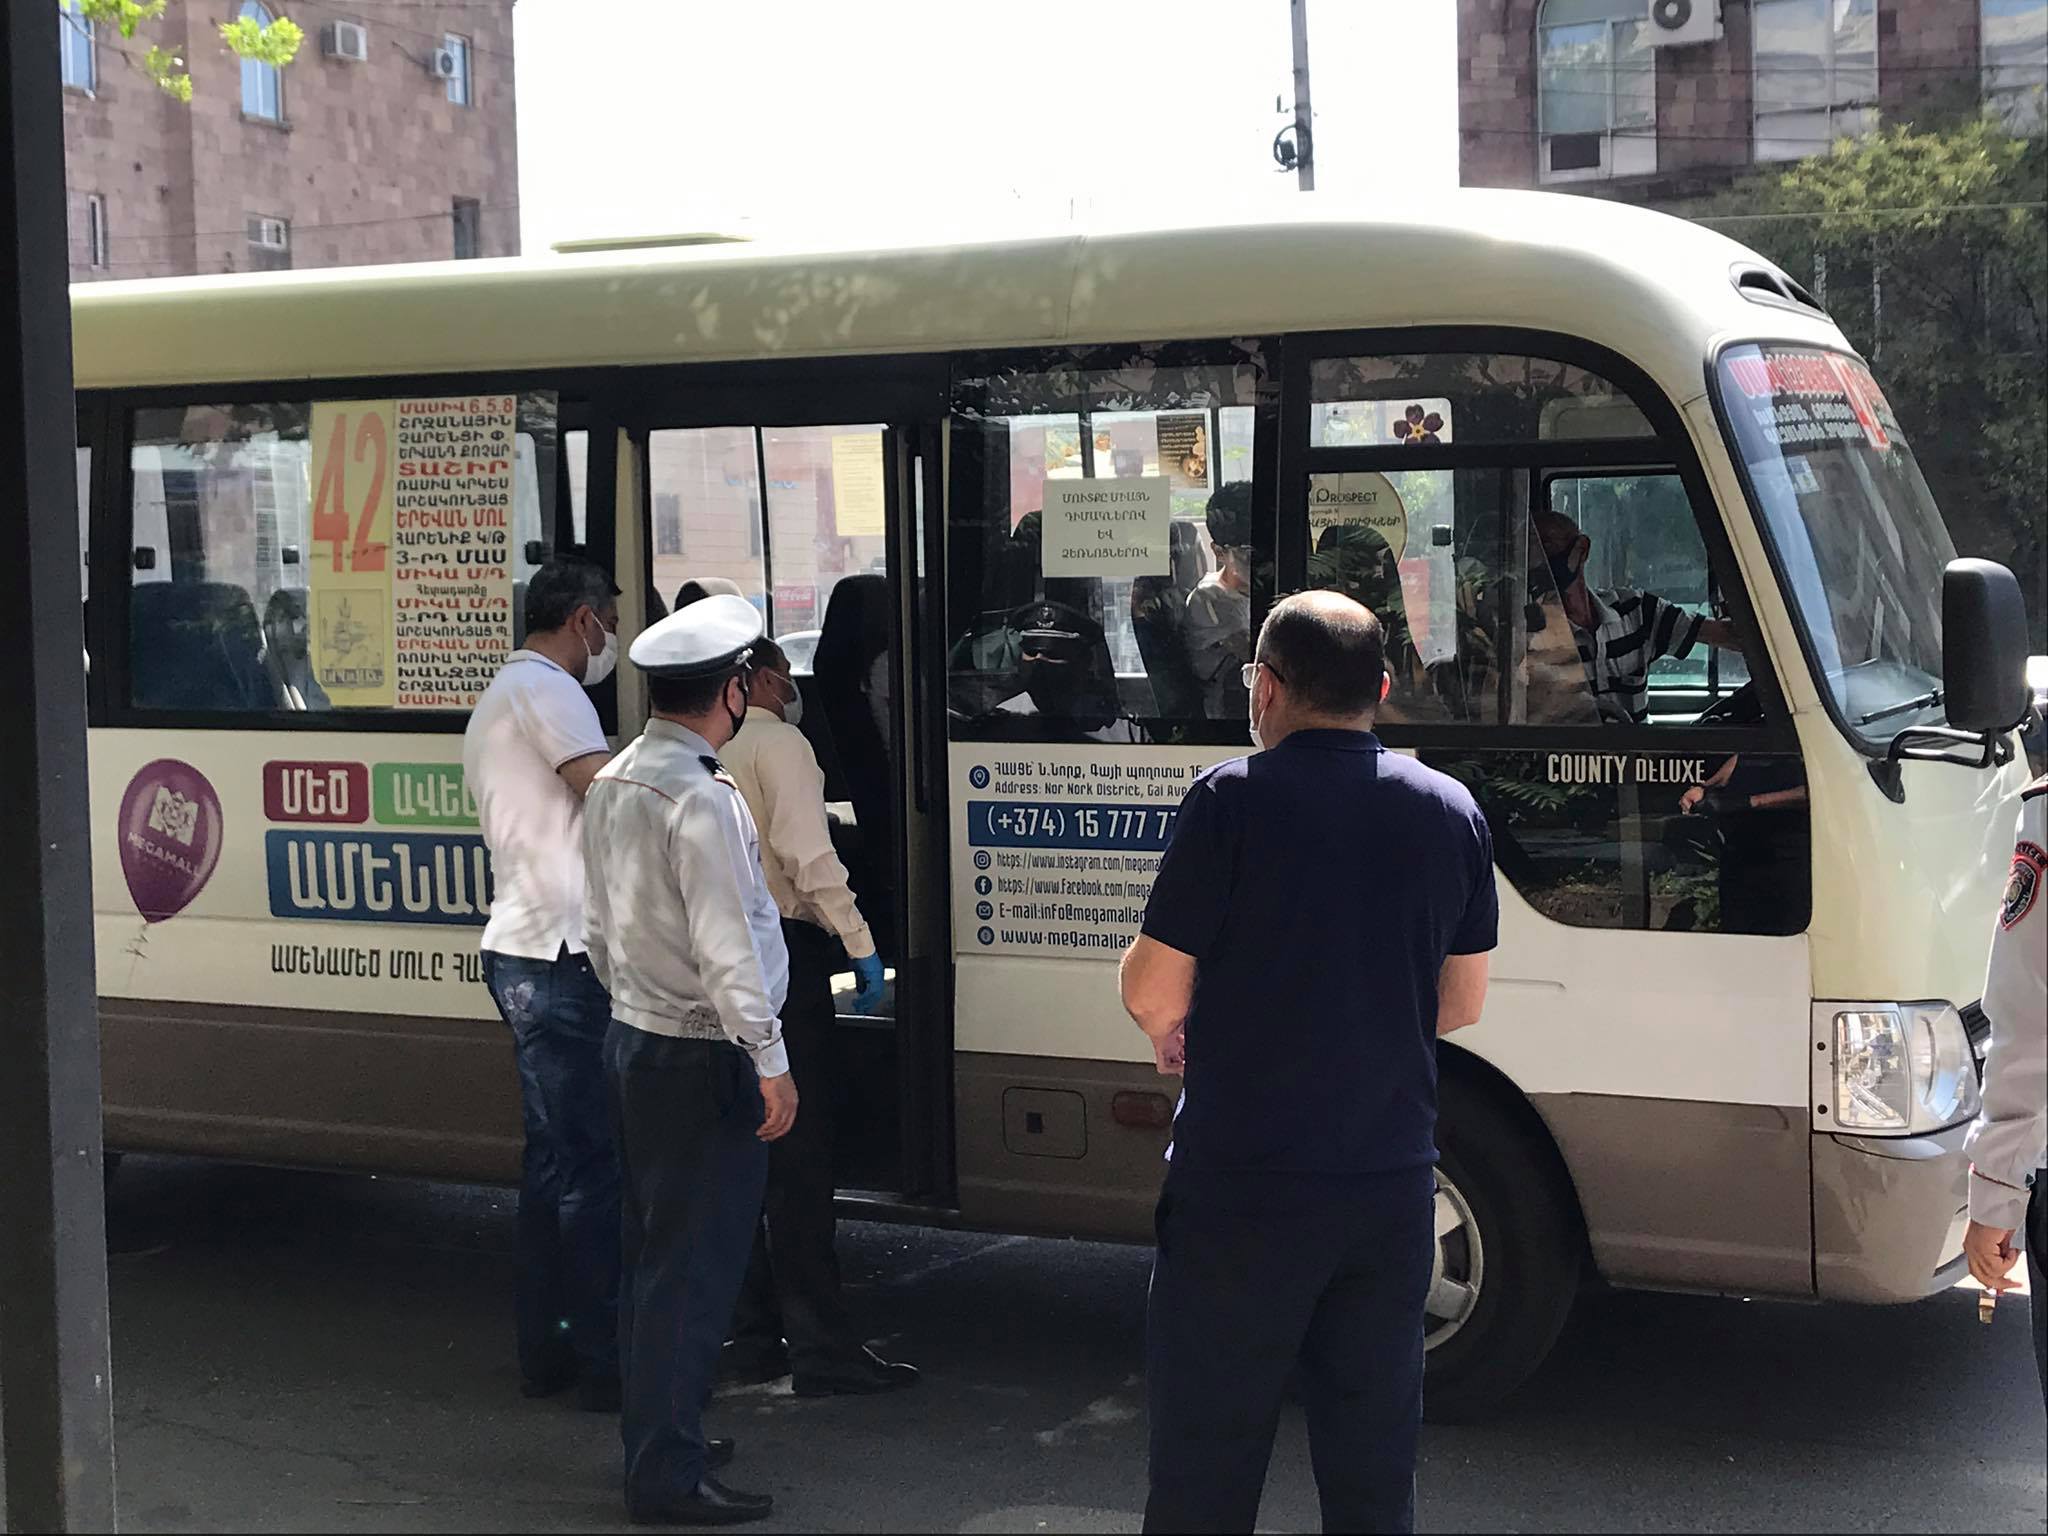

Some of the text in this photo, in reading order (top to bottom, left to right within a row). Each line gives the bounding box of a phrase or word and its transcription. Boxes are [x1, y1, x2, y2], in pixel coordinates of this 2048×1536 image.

[400, 402, 465, 414] ՄԱՍԻՎ
[399, 415, 512, 430] ՇՐՋԱՆԱՅԻՆ
[399, 430, 484, 444] ՉԱՐԵՆՑԻ
[399, 444, 510, 459] ԵՐՎԱՆԴ ՔՈՉԱՐ
[399, 460, 509, 476] ՏԱՇԻՐ
[313, 411, 386, 572] 42
[1062, 491, 1150, 503] ՄՈՒՏՔԸ ՄԻԱՅՆ
[396, 508, 507, 528] ԵՐԵՎԱՆ ՄՈԼ
[1097, 529, 1114, 540] ԵՎ
[456, 549, 506, 564] ՄԱՍ
[396, 567, 506, 580] ՄԻԿԱ Մ/Դ
[397, 598, 460, 608] ՄԻԿԱ
[456, 612, 507, 622] ՄԱՍ
[397, 639, 509, 650] ԵՐԵՎԱՆ ՄՈԼ
[398, 666, 500, 679] ԽԱՆՋՅԱ
[398, 680, 490, 692] ՇՐՋԱՆԱՅ
[399, 694, 461, 705] ՄԱՍԻՎ
[1090, 763, 1121, 779] Գայի
[1126, 765, 1184, 780] պողոտա
[1547, 753, 1628, 784] COUNTY
[282, 769, 350, 816] ՄԵԾ
[995, 781, 1041, 794] Address:
[1045, 782, 1063, 795] Nor
[1067, 783, 1093, 795] Nork
[988, 805, 1177, 839] (+374) 15 777 7
[997, 852, 1161, 874] https://www.instagram.com/megama
[271, 944, 487, 982] ԱՄԵՆԱՄԵԾ ՄՈԼԸ ՀԱ
